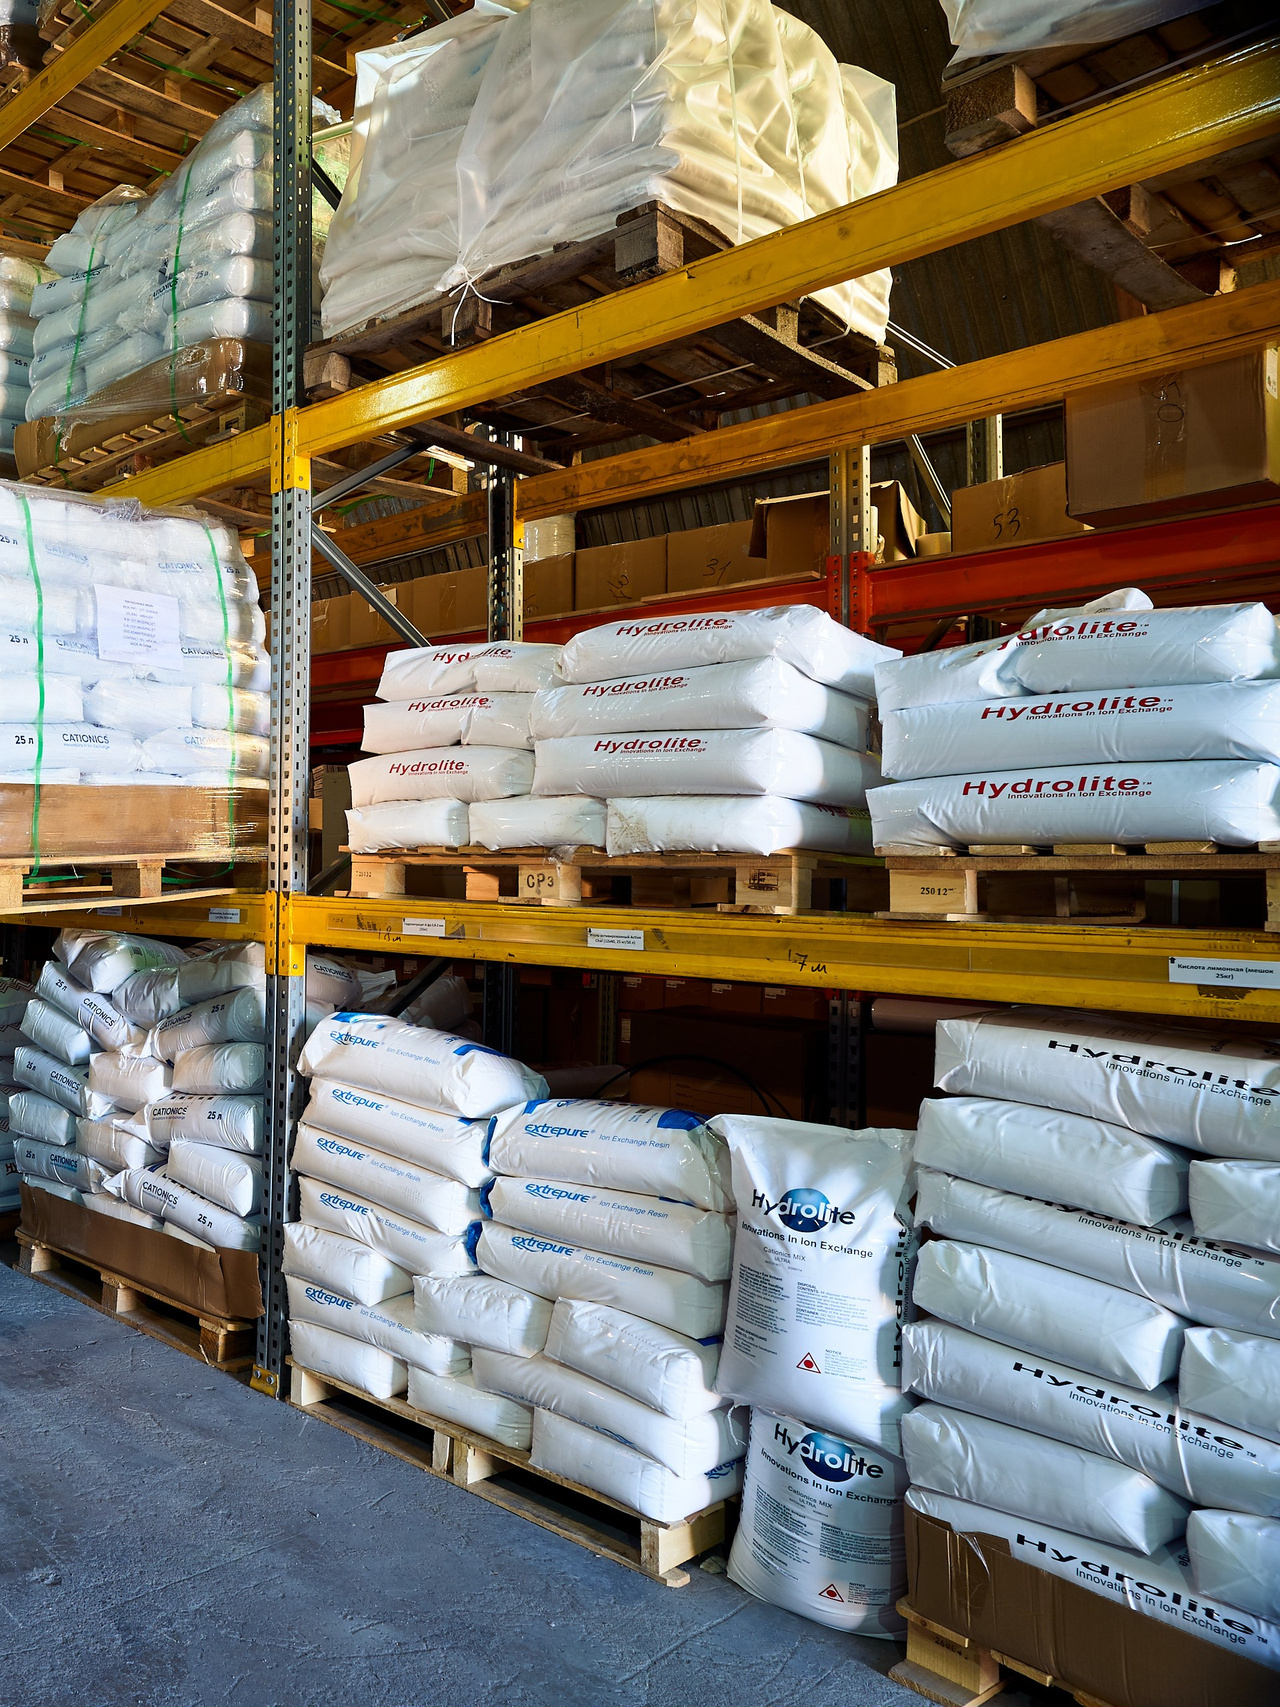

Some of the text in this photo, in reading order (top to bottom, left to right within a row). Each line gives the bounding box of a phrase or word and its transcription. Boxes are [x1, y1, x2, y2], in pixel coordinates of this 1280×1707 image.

[993, 507, 1021, 539] 53
[0, 534, 10, 544] 25
[616, 618, 729, 637] Hydrolite
[996, 621, 1138, 651] drolite
[9, 634, 21, 644] 25
[1015, 635, 1063, 647] Innovations
[1097, 630, 1148, 639] Exchange
[433, 648, 512, 664] Hydlite
[582, 676, 684, 698] Hydrolite
[408, 696, 489, 713] Hydrolite
[981, 696, 1161, 721] Hydrolite
[1026, 711, 1083, 721] Innovations
[1118, 705, 1173, 715] Exchange
[14, 735, 27, 745] 25
[62, 732, 110, 745] CATIONICS
[594, 738, 702, 754] Hydrolite
[389, 760, 464, 777] Hydrolite
[962, 776, 1140, 799] Hydrolite
[1007, 792, 1064, 800] Innovations
[1098, 789, 1152, 798] Exchange
[55, 978, 65, 989] 25
[83, 997, 116, 1028] CATIONICS
[211, 1003, 220, 1014] 25
[26, 1060, 33, 1070] 25
[396, 1048, 424, 1062] Exchange
[425, 1055, 441, 1066] Resin
[1048, 1040, 1280, 1096] Hydrolite
[50, 1070, 81, 1091] CATIONICS
[1106, 1060, 1272, 1107] Innovations In Ion Exchange
[152, 1105, 188, 1117] CATIONICS
[207, 1110, 216, 1120] 25
[390, 1109, 399, 1117] Ion
[400, 1111, 427, 1128] Exchange
[428, 1122, 444, 1134] Resin
[599, 1133, 670, 1149] Ion Exchange Resin
[50, 1153, 78, 1168] CATIONICS
[370, 1158, 421, 1183] Ion Exchange Resin
[143, 1181, 179, 1206] CATIONICS
[599, 1200, 669, 1219] Ion Exchange Resin
[752, 1188, 856, 1225] Hydrolite
[197, 1212, 208, 1225] 25
[788, 1234, 798, 1244] In
[800, 1236, 817, 1248] Ion
[820, 1240, 873, 1259] Exchange
[1078, 1215, 1243, 1268] Innovations In Ion Exchange
[763, 1246, 806, 1262] Cationics MIX
[774, 1256, 791, 1265] ULTRA
[583, 1253, 654, 1277] Ion Exchange Resin
[1013, 1362, 1244, 1451] Hydrolite
[1069, 1390, 1235, 1460] Innovations In Ion Exchange
[774, 1422, 884, 1479] Hydrolite
[761, 1447, 809, 1485] Innovations
[812, 1479, 822, 1490] In
[825, 1484, 843, 1497] Ion
[846, 1491, 899, 1507] Exchange
[787, 1485, 833, 1510] Cationics MIX
[798, 1497, 817, 1509] ULTRA
[1017, 1533, 1254, 1636] Hydrolite
[1075, 1567, 1247, 1646] Innovations In Ion Exchange
